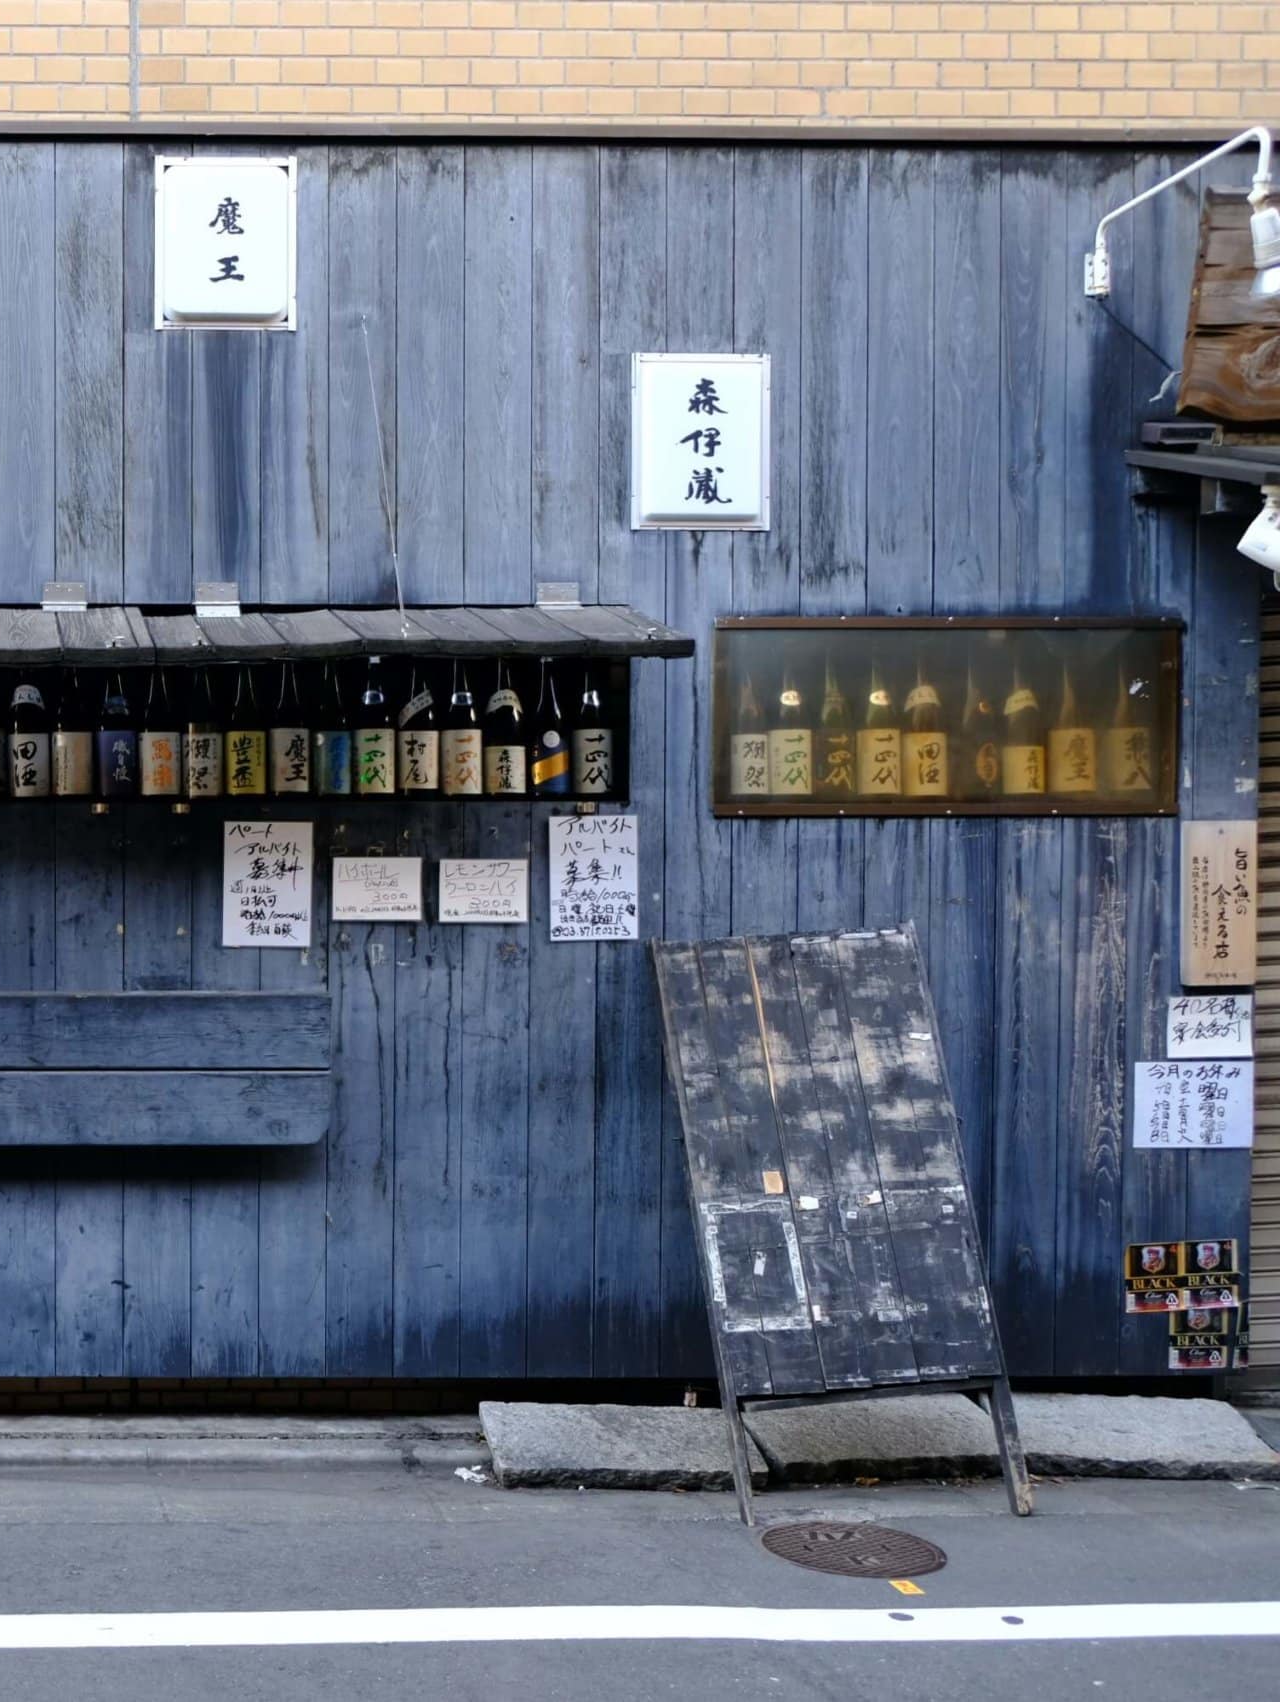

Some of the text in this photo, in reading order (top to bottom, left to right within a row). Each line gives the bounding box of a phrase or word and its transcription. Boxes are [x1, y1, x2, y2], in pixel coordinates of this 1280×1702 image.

[208, 197, 245, 283] 魔王
[680, 378, 733, 505] 森伊蔵
[13, 741, 37, 787] 田酒
[285, 734, 307, 782] 魔王
[361, 733, 386, 788] 十四代
[404, 733, 429, 785] 村尾
[455, 735, 479, 789] 十四代
[582, 733, 614, 792] 十四代
[781, 735, 808, 790] 十四代
[872, 733, 898, 789] 十四代
[918, 742, 940, 785] 田酒
[1064, 734, 1090, 782] 魔王
[229, 823, 273, 838] パート
[234, 842, 303, 857] アルバイト
[558, 816, 632, 836] アルバイト
[445, 862, 525, 879] レモンサワー
[1233, 848, 1251, 915] 旨い魚の
[1211, 883, 1232, 959] 食える店
[1148, 1064, 1241, 1081] 今月のお休み
[1132, 1278, 1177, 1290] BLACK
[1187, 1274, 1231, 1286] BLACK
[1176, 1335, 1219, 1346] BLACK
